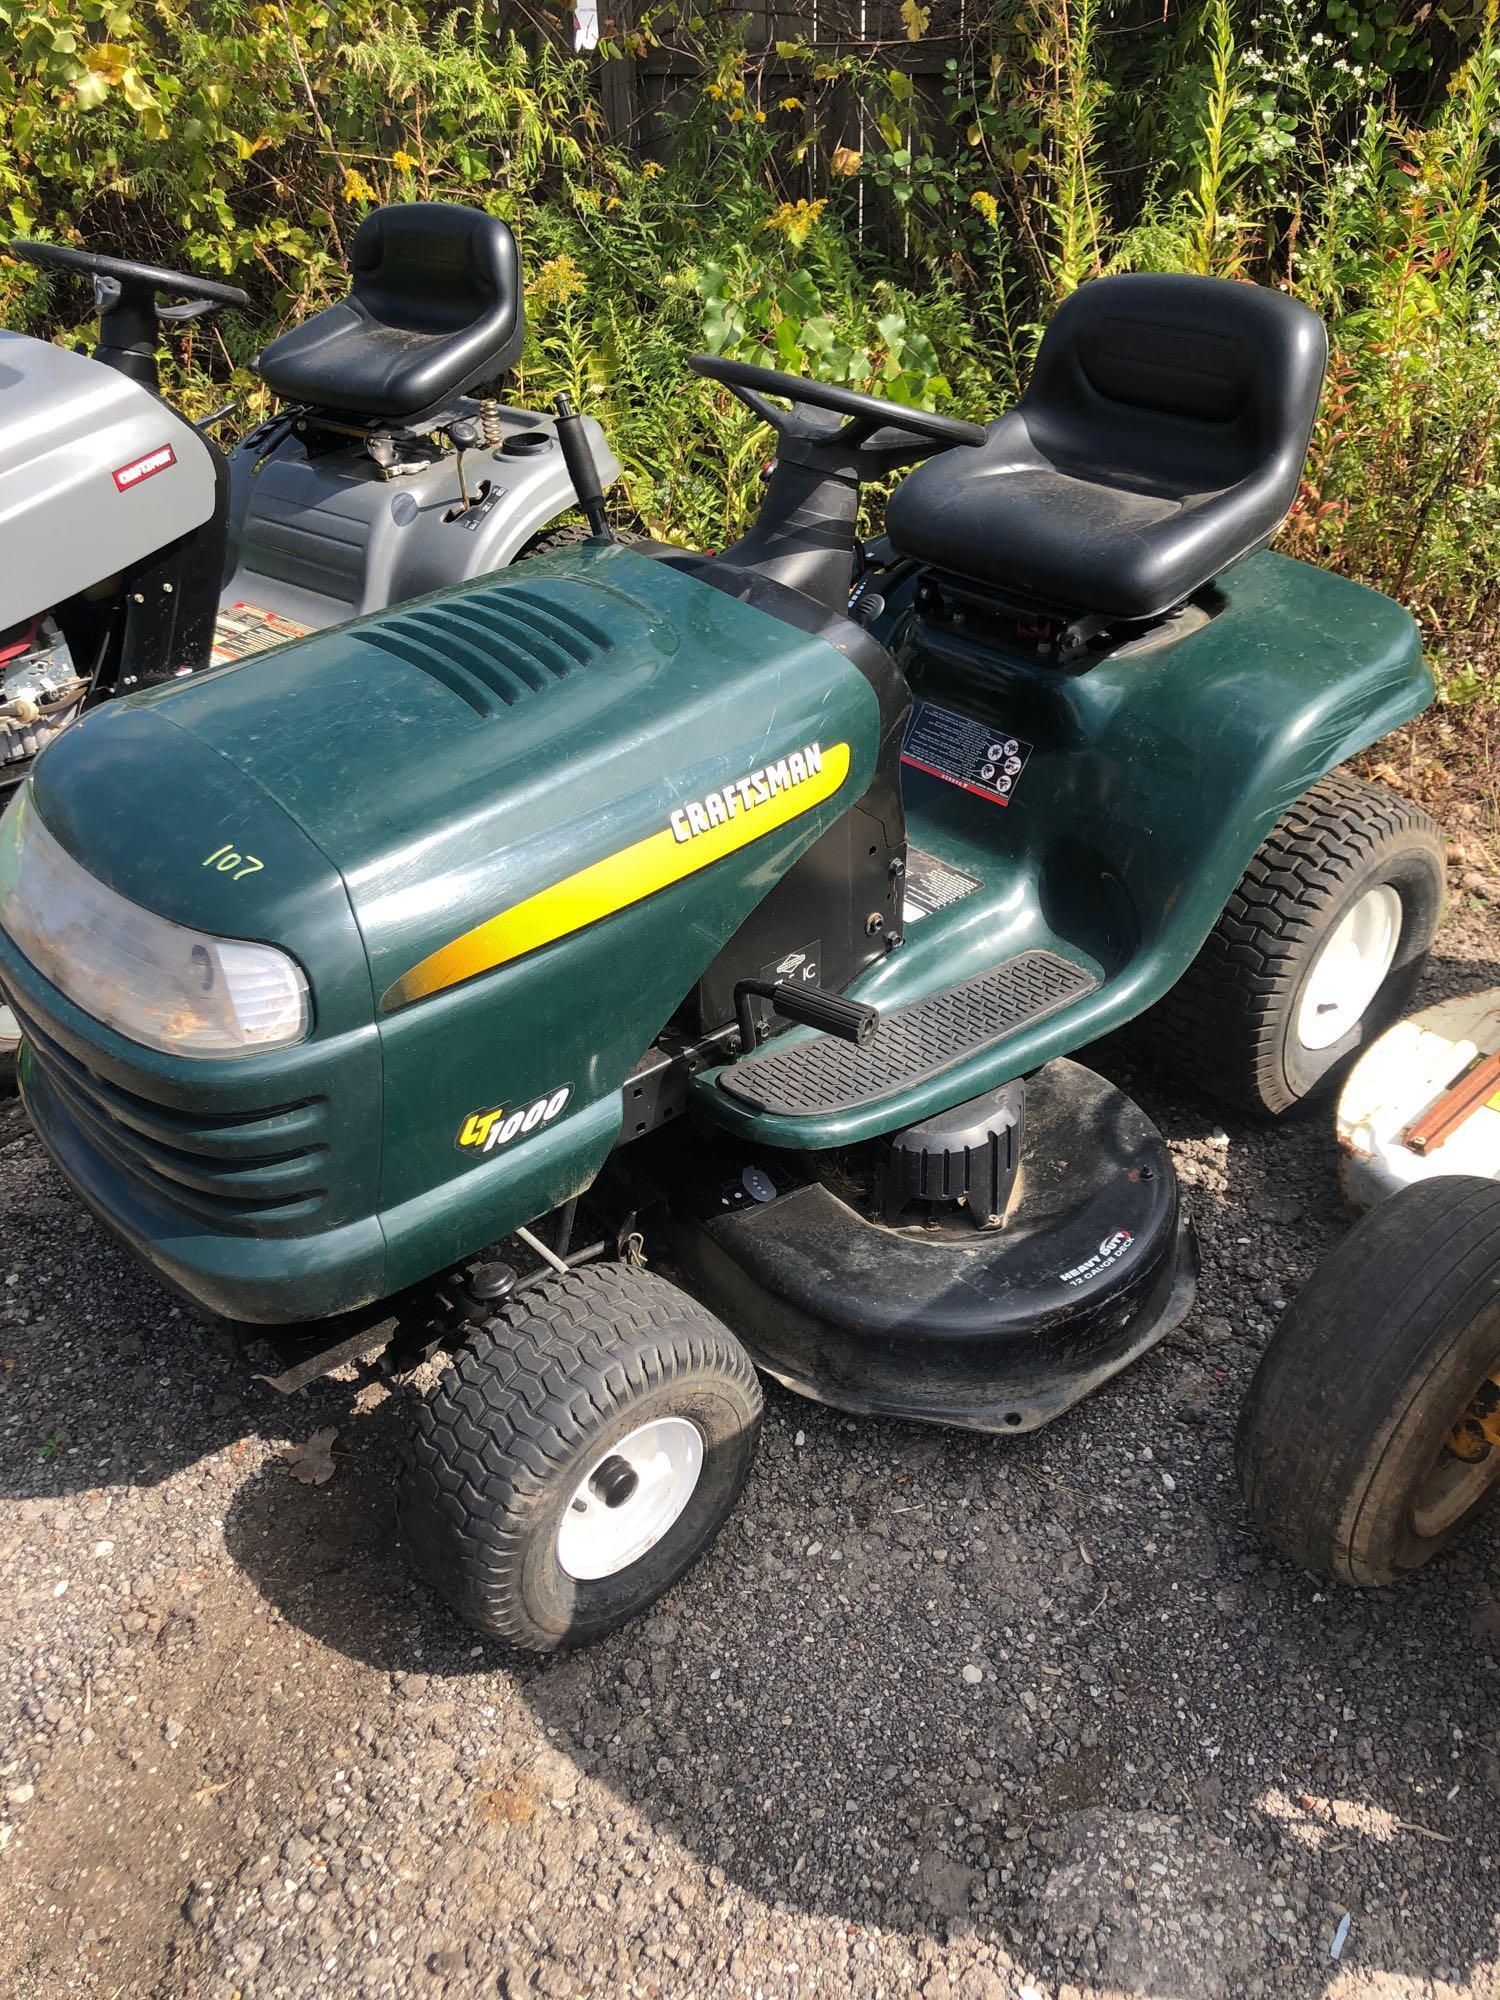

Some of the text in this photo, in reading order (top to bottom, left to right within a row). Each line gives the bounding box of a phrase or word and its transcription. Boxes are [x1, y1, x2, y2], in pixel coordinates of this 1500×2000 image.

[670, 742, 822, 843] CRAFTSMAN
[202, 844, 265, 880] 107
[1059, 1232, 1125, 1281] HEAVY DUTY
[1069, 1277, 1085, 1286] 12
[1114, 1237, 1136, 1257] DECK
